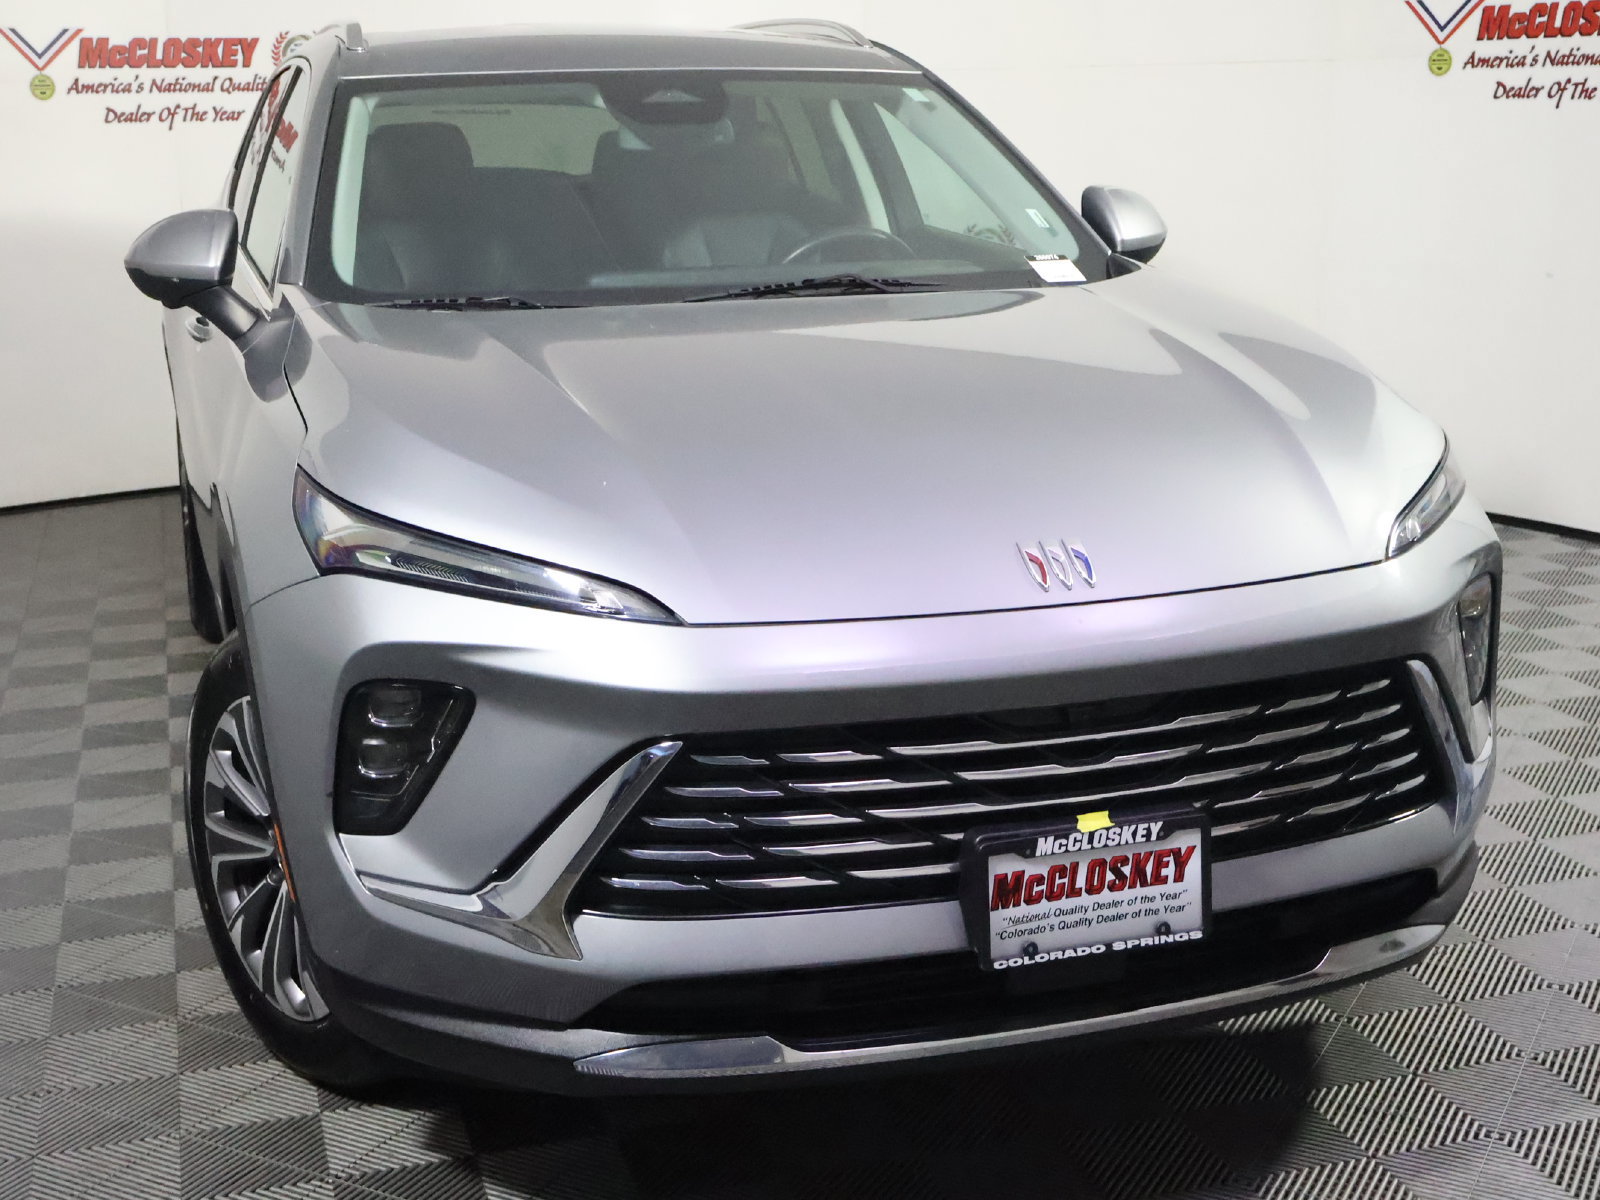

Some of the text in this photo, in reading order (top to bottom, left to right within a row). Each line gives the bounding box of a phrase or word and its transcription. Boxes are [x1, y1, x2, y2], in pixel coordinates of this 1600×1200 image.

[1476, 0, 1600, 41] McCLOS
[78, 37, 259, 69] McCLOSKEY
[1463, 45, 1539, 69] America's
[1542, 47, 1600, 68] Nationa
[67, 75, 145, 95] America's
[150, 75, 215, 94] National
[220, 74, 267, 96] Qualit
[1493, 77, 1598, 109] Dealer Of The
[104, 103, 245, 130] Dealer Of The Year
[1035, 821, 1164, 857] McCLOSKEY
[990, 845, 1198, 912] McCLOSKEY
[1053, 904, 1090, 918] Quality
[1092, 899, 1125, 912] Dealer
[1127, 896, 1138, 907] of
[1140, 893, 1156, 905] the
[1058, 917, 1094, 931] Quality
[1096, 912, 1129, 925] Dealer
[1131, 908, 1142, 920] of
[1144, 906, 1160, 917] the
[993, 930, 1203, 970] COLORADO SPRINGS
